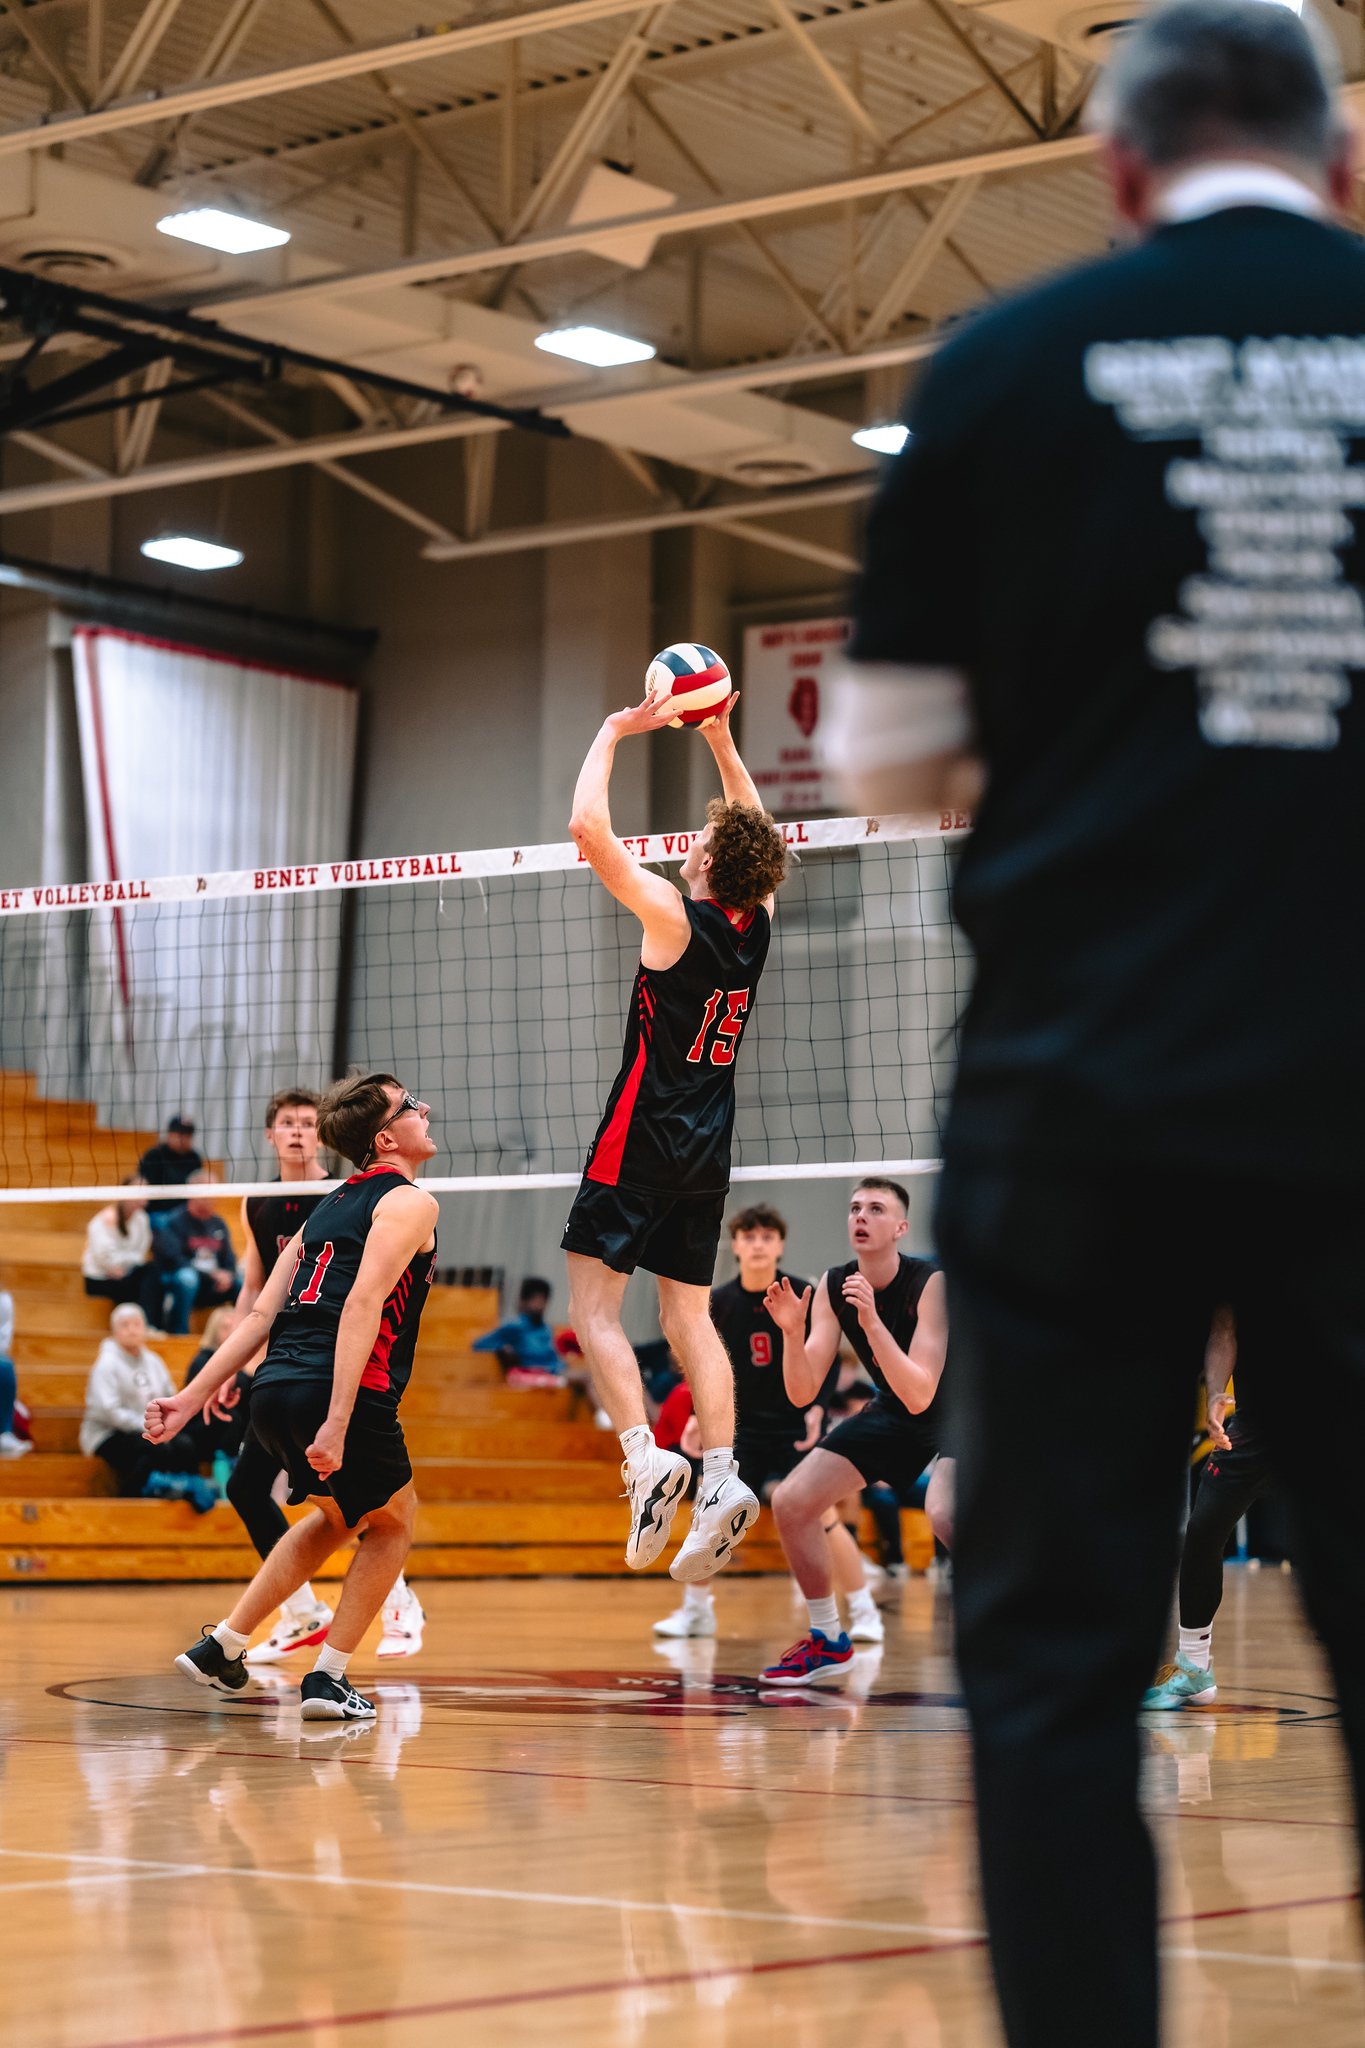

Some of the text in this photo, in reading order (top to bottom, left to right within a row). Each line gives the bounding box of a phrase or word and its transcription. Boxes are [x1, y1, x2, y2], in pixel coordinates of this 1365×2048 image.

[254, 854, 462, 890] BENET VOLLEYBALL
[33, 880, 151, 907] VOLLEYBALL
[686, 987, 750, 1066] 15
[751, 1332, 772, 1367] 9
